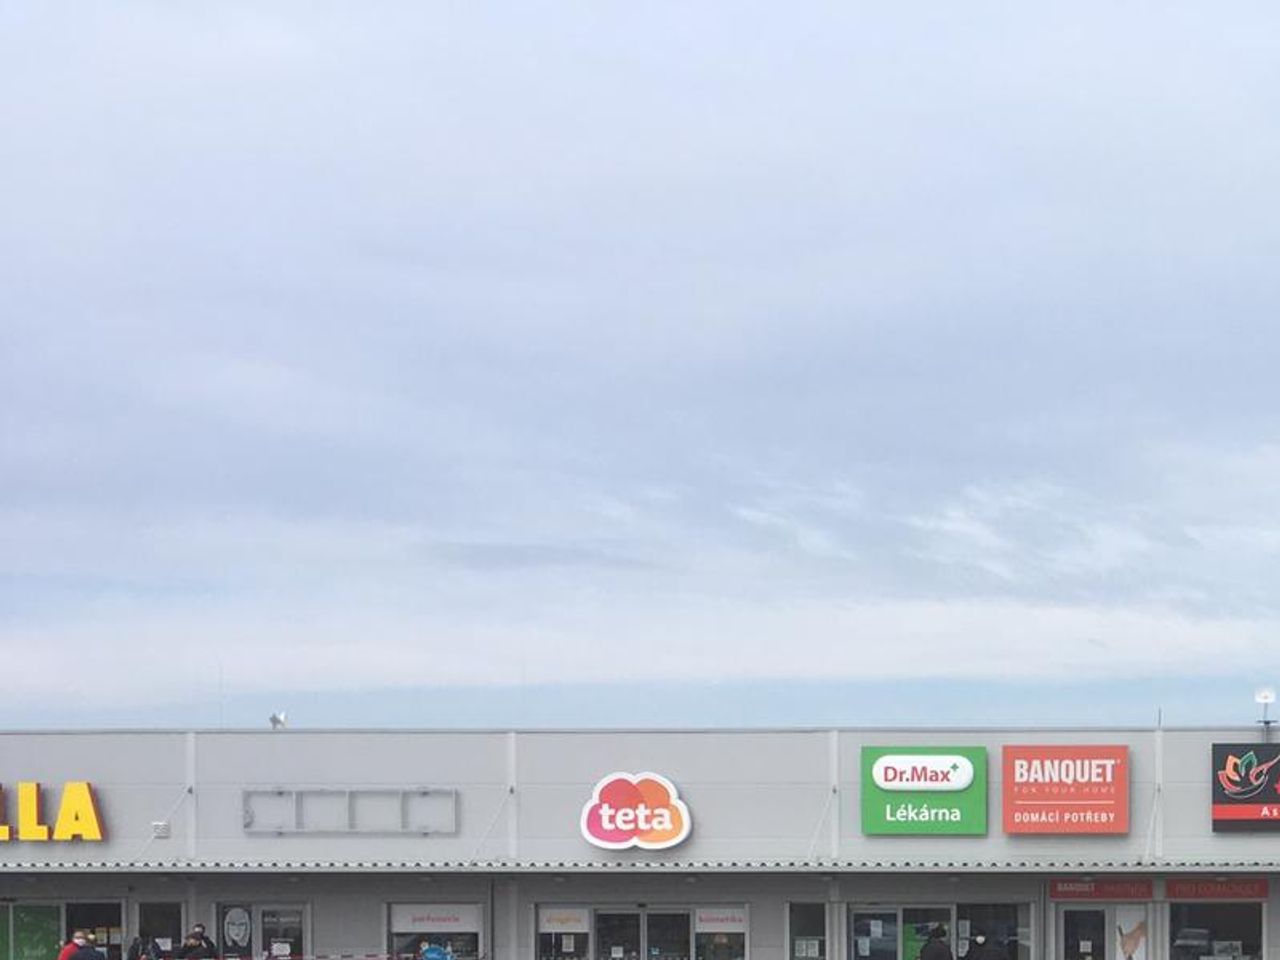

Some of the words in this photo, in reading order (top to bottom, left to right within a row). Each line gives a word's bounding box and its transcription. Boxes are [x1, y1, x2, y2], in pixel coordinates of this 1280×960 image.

[599, 803, 673, 831] teta
[885, 803, 961, 821] Lékárna
[1014, 809, 1059, 823] DOMÁCÍ
[1063, 809, 1115, 823] POTŘEBY
